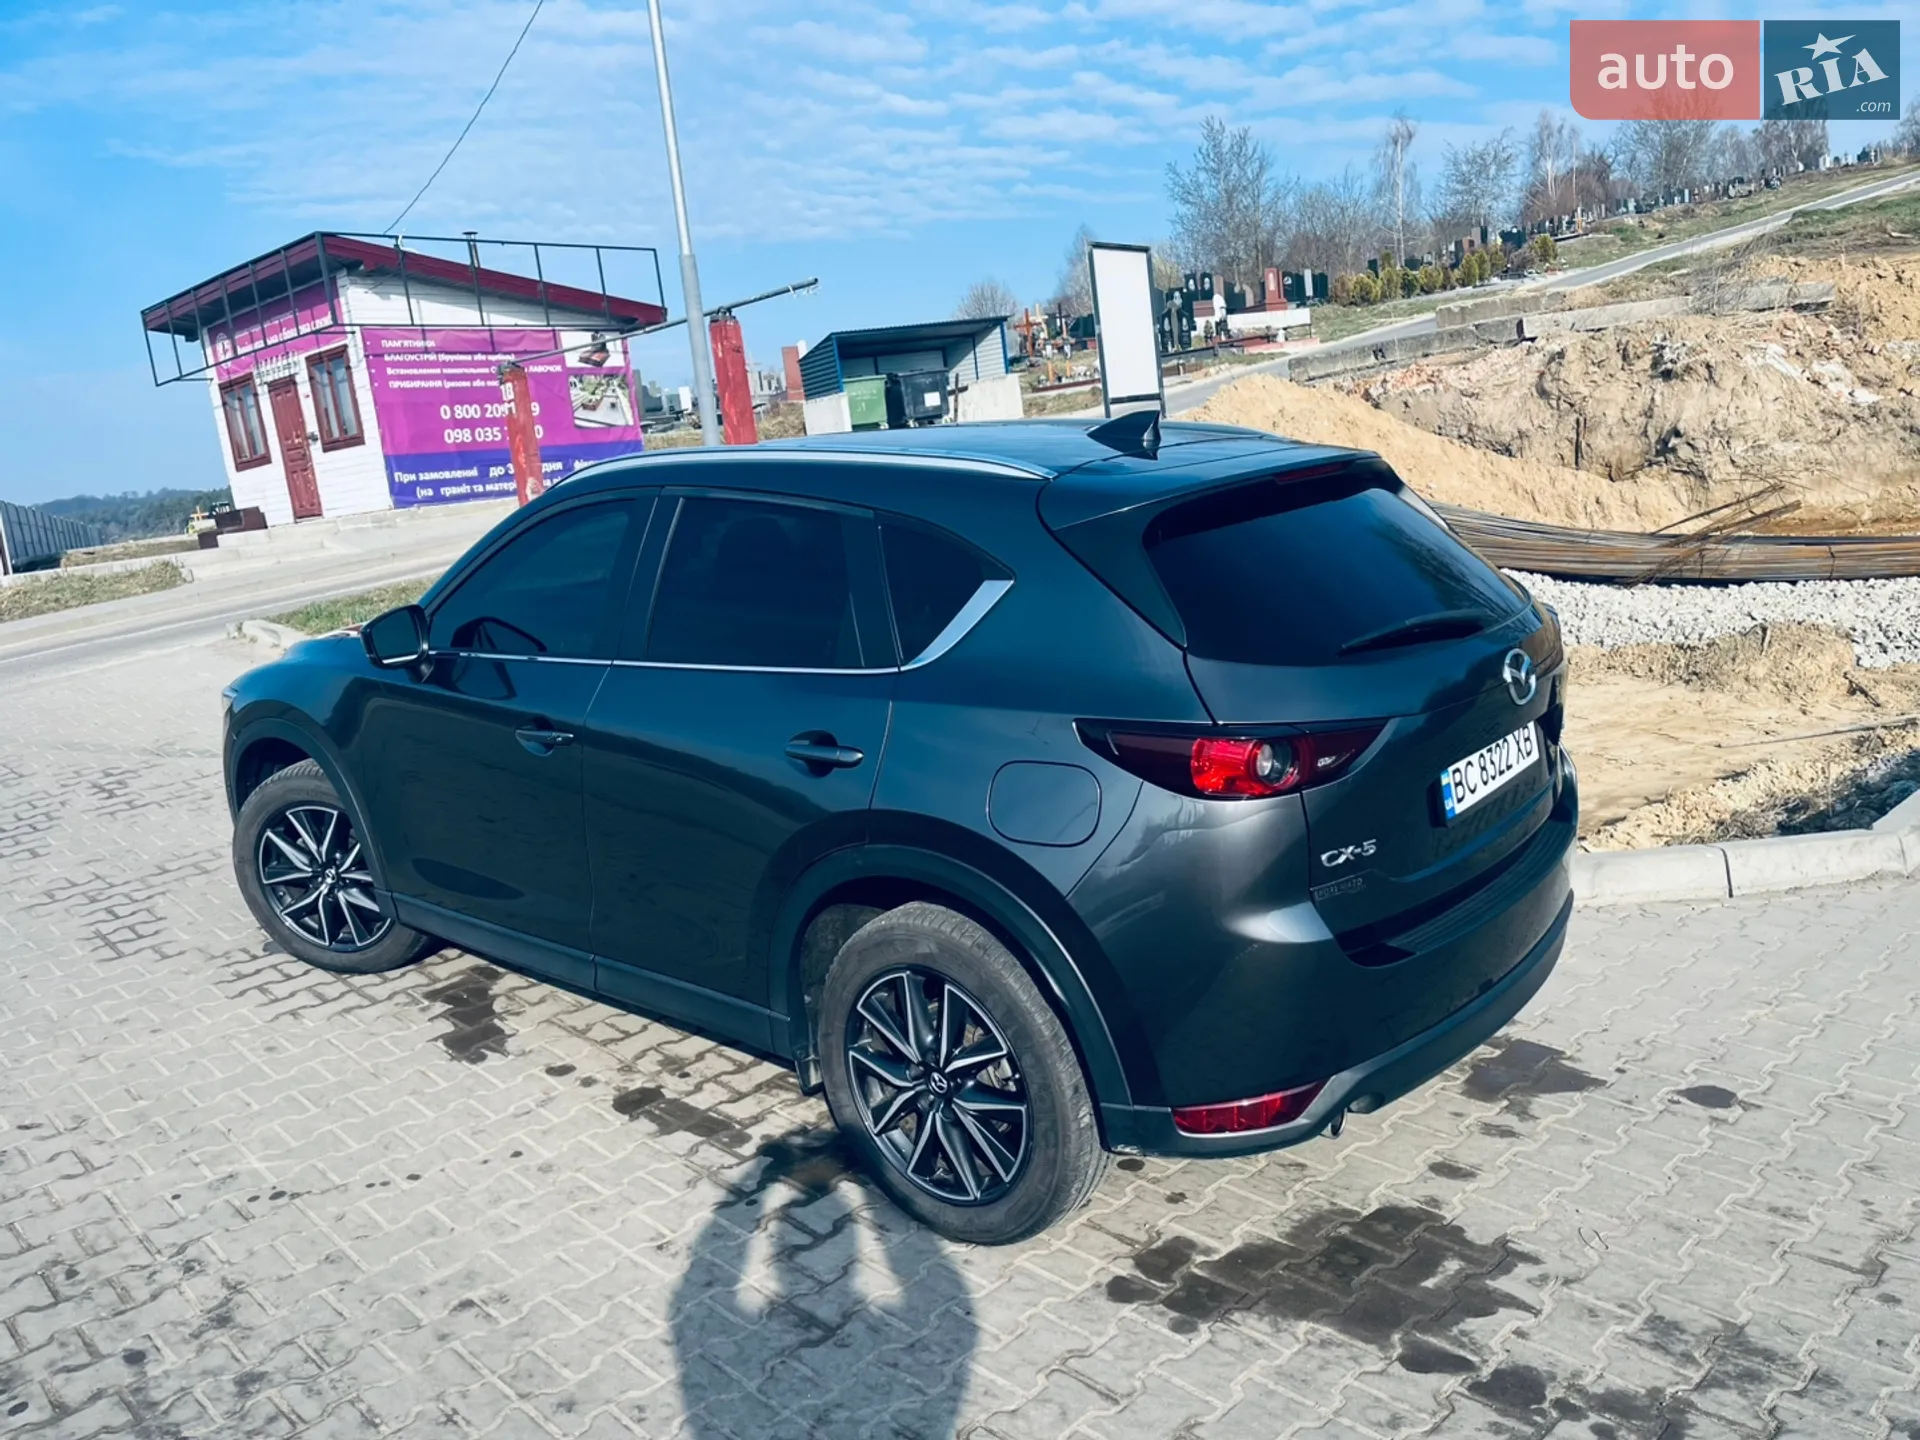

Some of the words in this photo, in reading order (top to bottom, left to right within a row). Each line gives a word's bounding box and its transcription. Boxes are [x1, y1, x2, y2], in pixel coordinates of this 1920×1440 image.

[440, 405, 451, 419] 0
[453, 404, 481, 419] 800
[444, 428, 472, 443] 098
[474, 427, 502, 442] 035
[394, 471, 417, 484] При
[418, 467, 478, 481] замовленні
[489, 466, 505, 478] до
[416, 486, 434, 499] (на
[440, 484, 471, 497] граніт
[472, 484, 484, 493] та
[1452, 767, 1477, 804] BC
[1478, 738, 1513, 786] 8322
[1511, 725, 1533, 765] XB
[1320, 838, 1377, 867] CX-5
